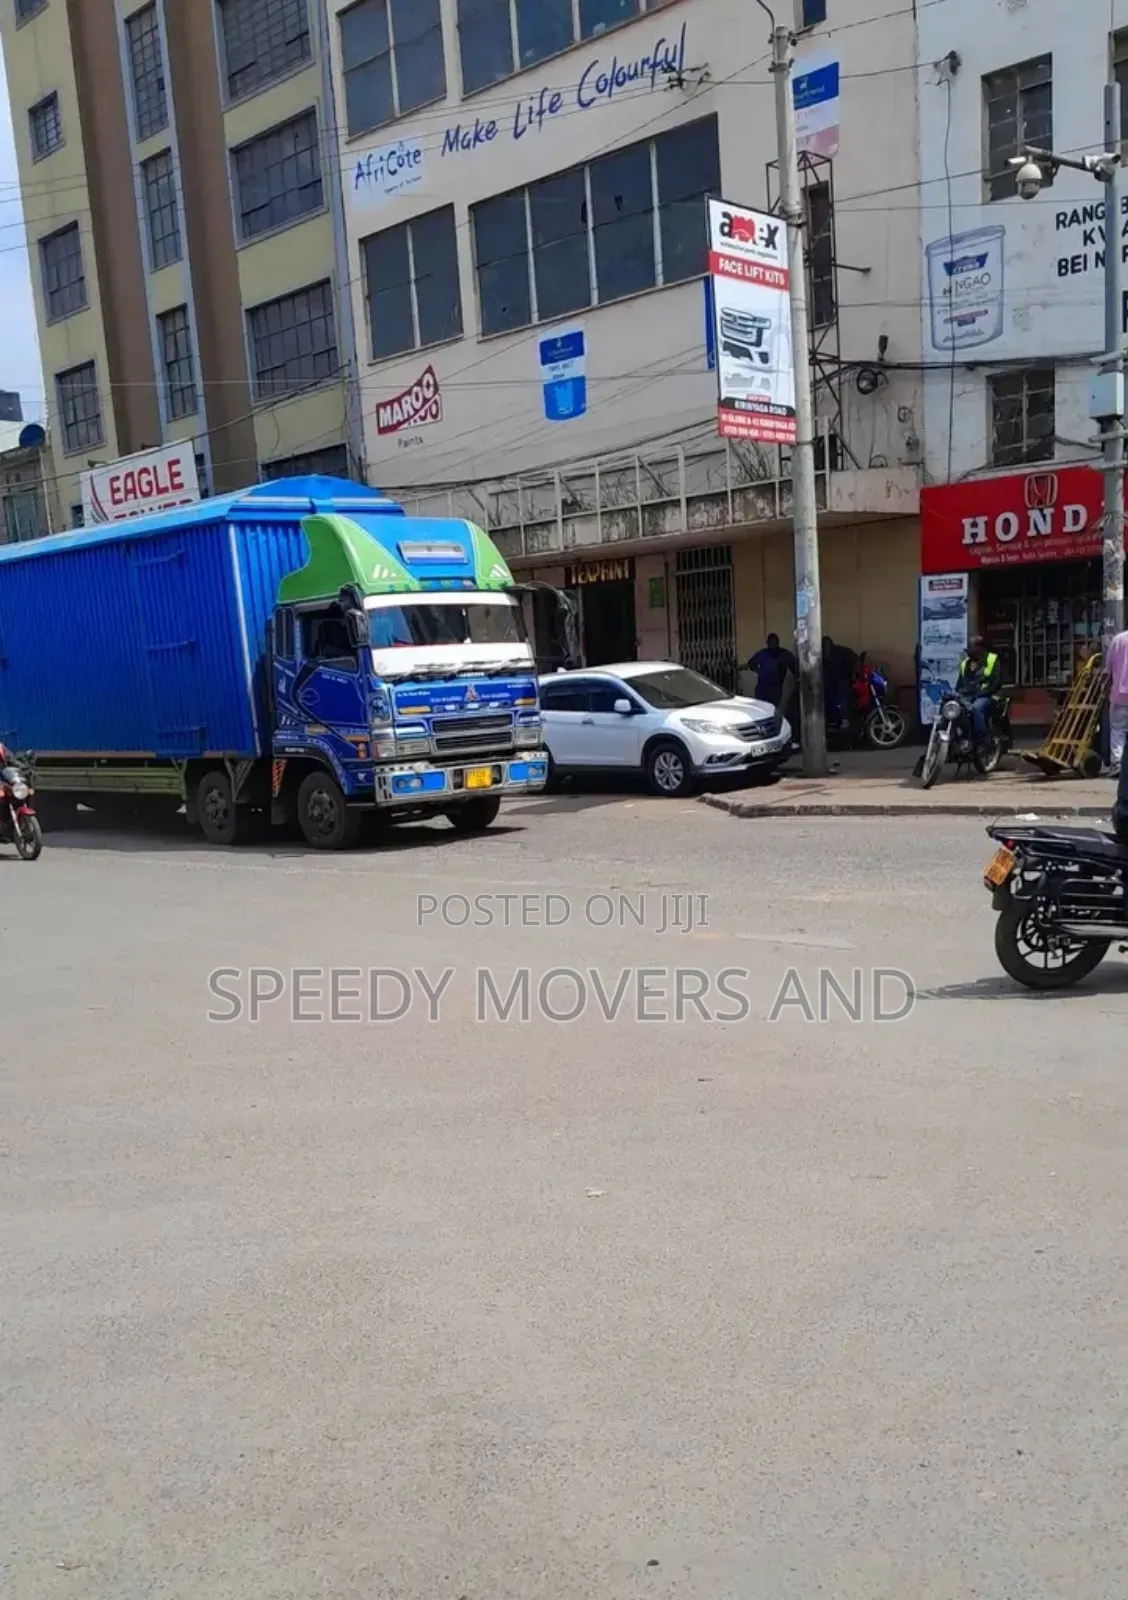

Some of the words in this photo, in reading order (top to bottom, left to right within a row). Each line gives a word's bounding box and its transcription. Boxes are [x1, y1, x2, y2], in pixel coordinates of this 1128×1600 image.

[441, 117, 498, 156] Make
[513, 87, 563, 139] Life
[578, 21, 687, 107] Colourful
[1055, 202, 1106, 230] RANG
[718, 257, 743, 275] FACE
[745, 264, 763, 281] LIFT
[765, 270, 785, 286] KITS
[1057, 254, 1088, 277] BEI
[380, 372, 435, 429] MAROO
[397, 436, 424, 449] Paints
[109, 458, 184, 506] EAGLE
[961, 503, 1090, 545] HOND
